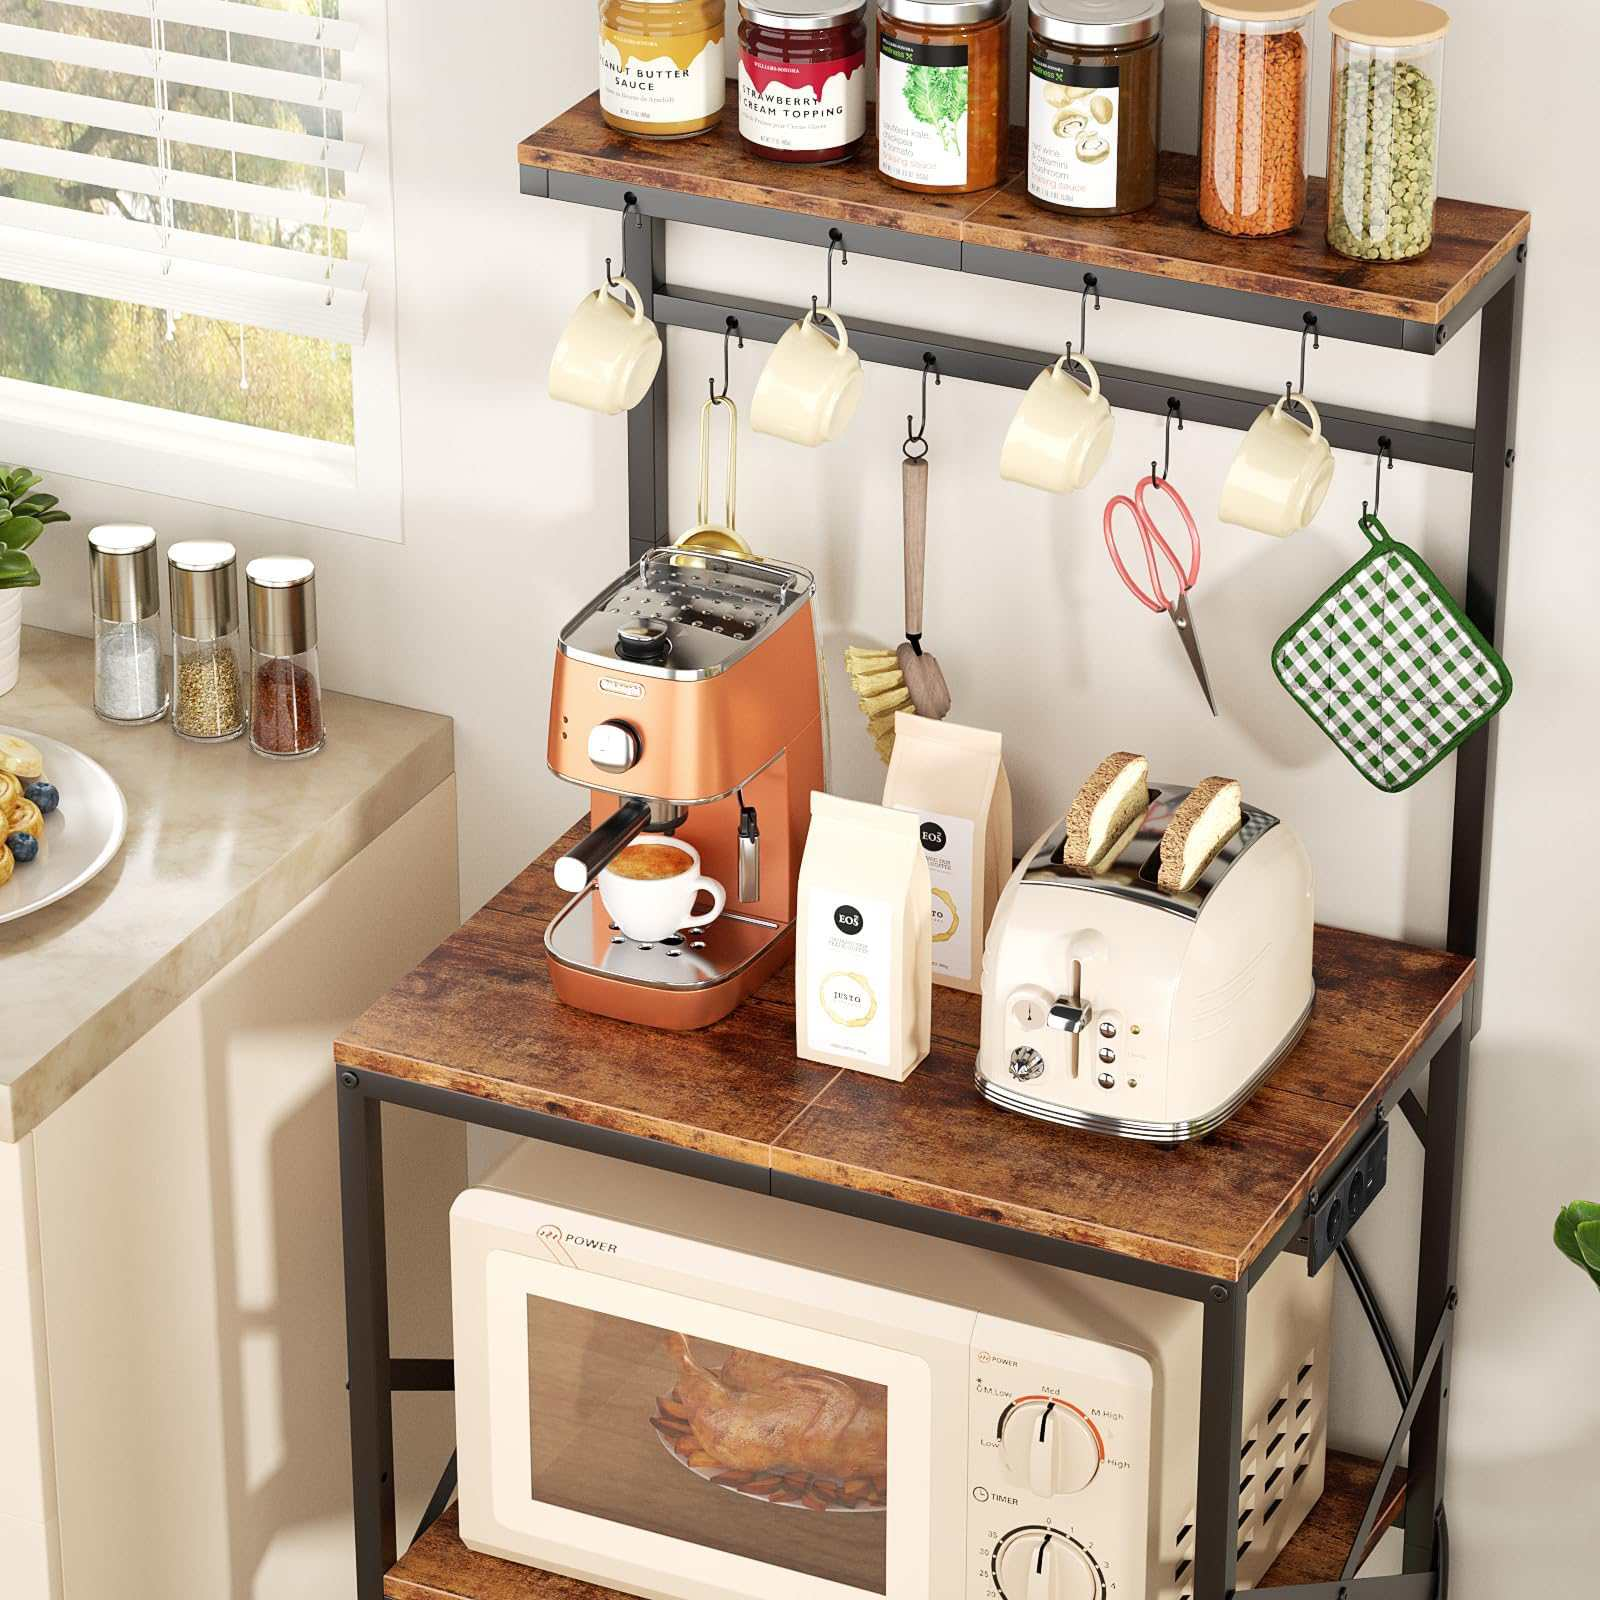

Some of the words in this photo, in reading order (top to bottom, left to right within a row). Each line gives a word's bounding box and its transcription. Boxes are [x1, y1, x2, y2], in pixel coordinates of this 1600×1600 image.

[637, 69, 690, 79] BUTTER
[615, 77, 655, 91] SAUCE
[742, 84, 818, 106] STRAWBERRY
[743, 97, 776, 116] CREAM
[783, 105, 843, 118] TOPPING
[564, 1233, 618, 1254] POWER
[991, 1356, 1018, 1367] POWER
[1041, 1385, 1061, 1396] Med
[980, 1439, 1001, 1448] Low
[1107, 1458, 1131, 1470] High
[991, 1493, 1019, 1506] TIMER
[1046, 1517, 1052, 1525] 0
[1088, 1541, 1094, 1549] 2
[1104, 1561, 1110, 1569] 3
[979, 1569, 989, 1578] 25
[1110, 1582, 1116, 1590] 4
